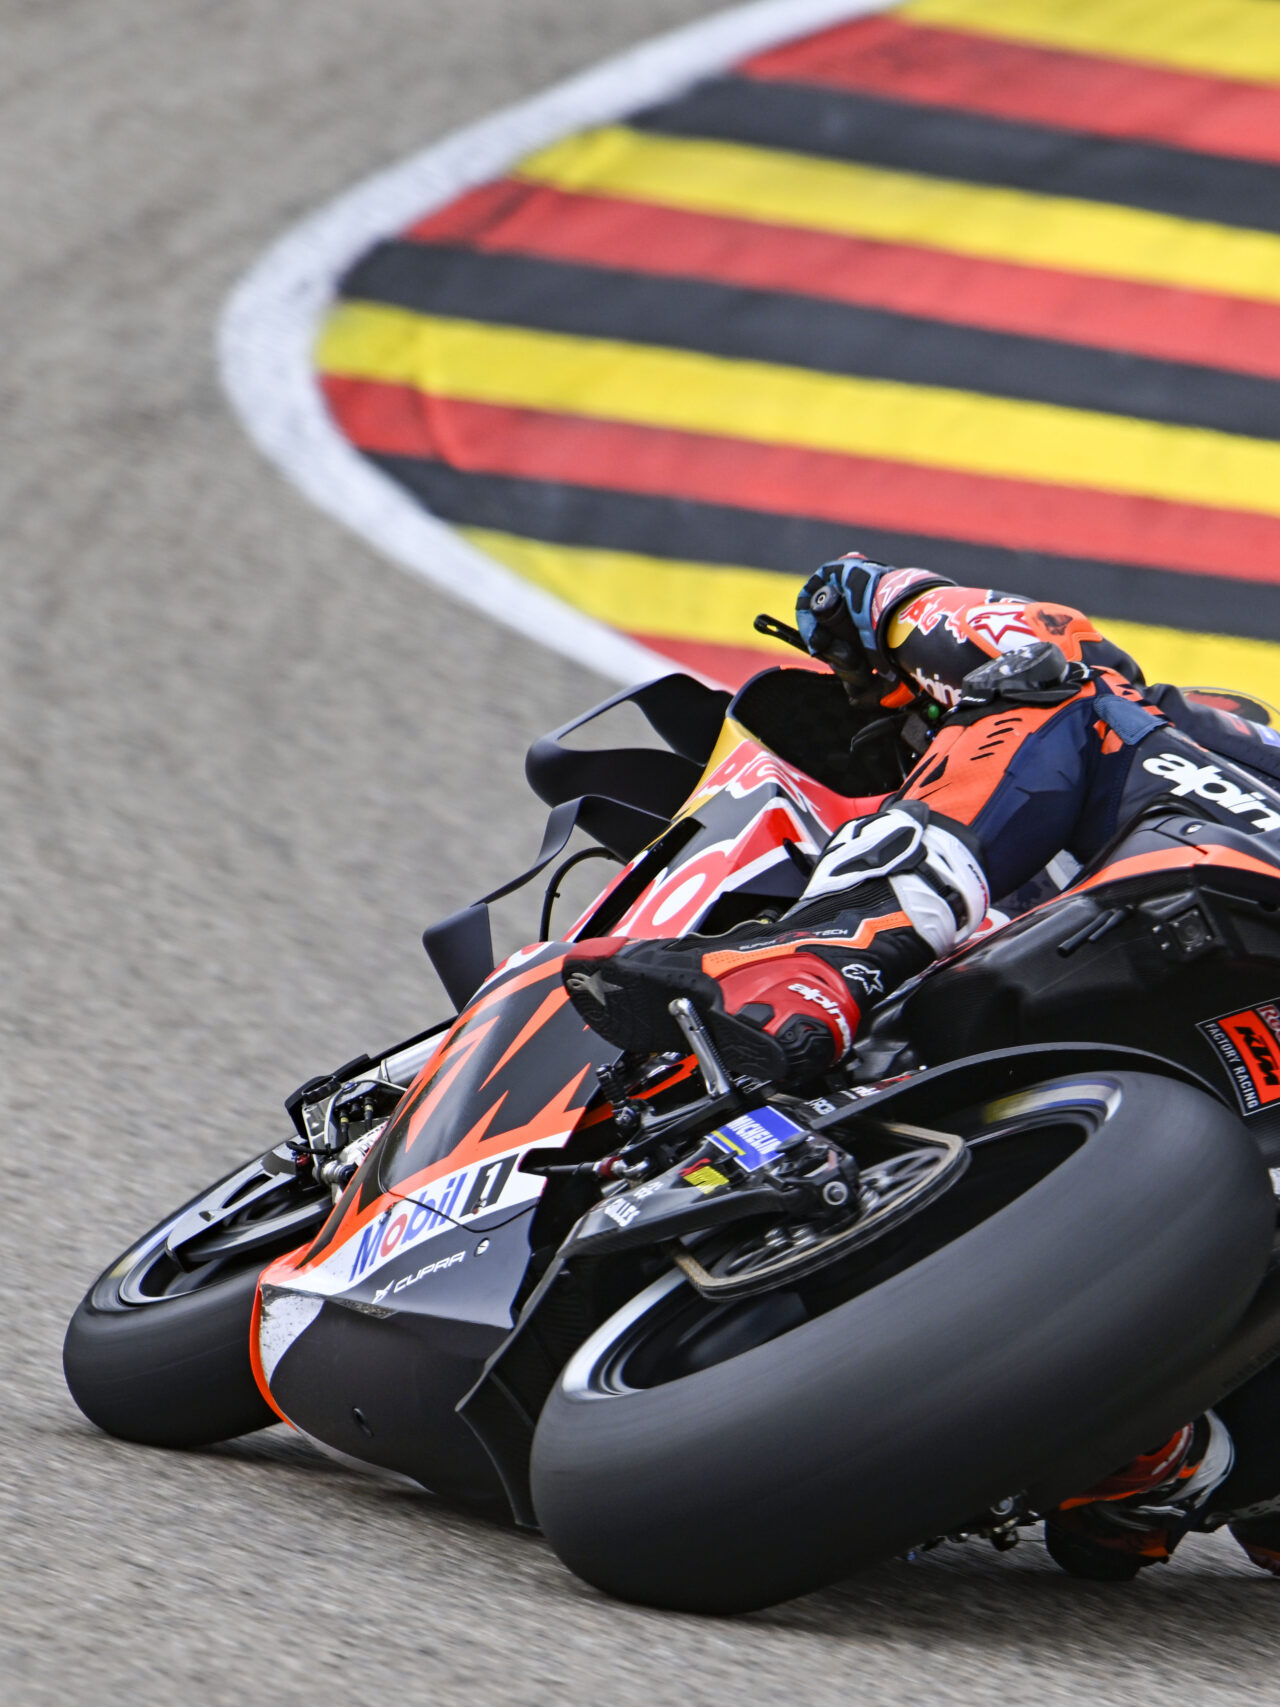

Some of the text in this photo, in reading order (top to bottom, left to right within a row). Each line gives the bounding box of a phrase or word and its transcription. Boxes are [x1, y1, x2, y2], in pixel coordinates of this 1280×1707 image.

[1205, 1023, 1260, 1109] FACTORY RACING
[1233, 1026, 1280, 1086] KTM
[722, 1114, 782, 1155] MICHELIN
[349, 1161, 504, 1283] Mobil 1
[393, 1250, 466, 1294] CUPRA
